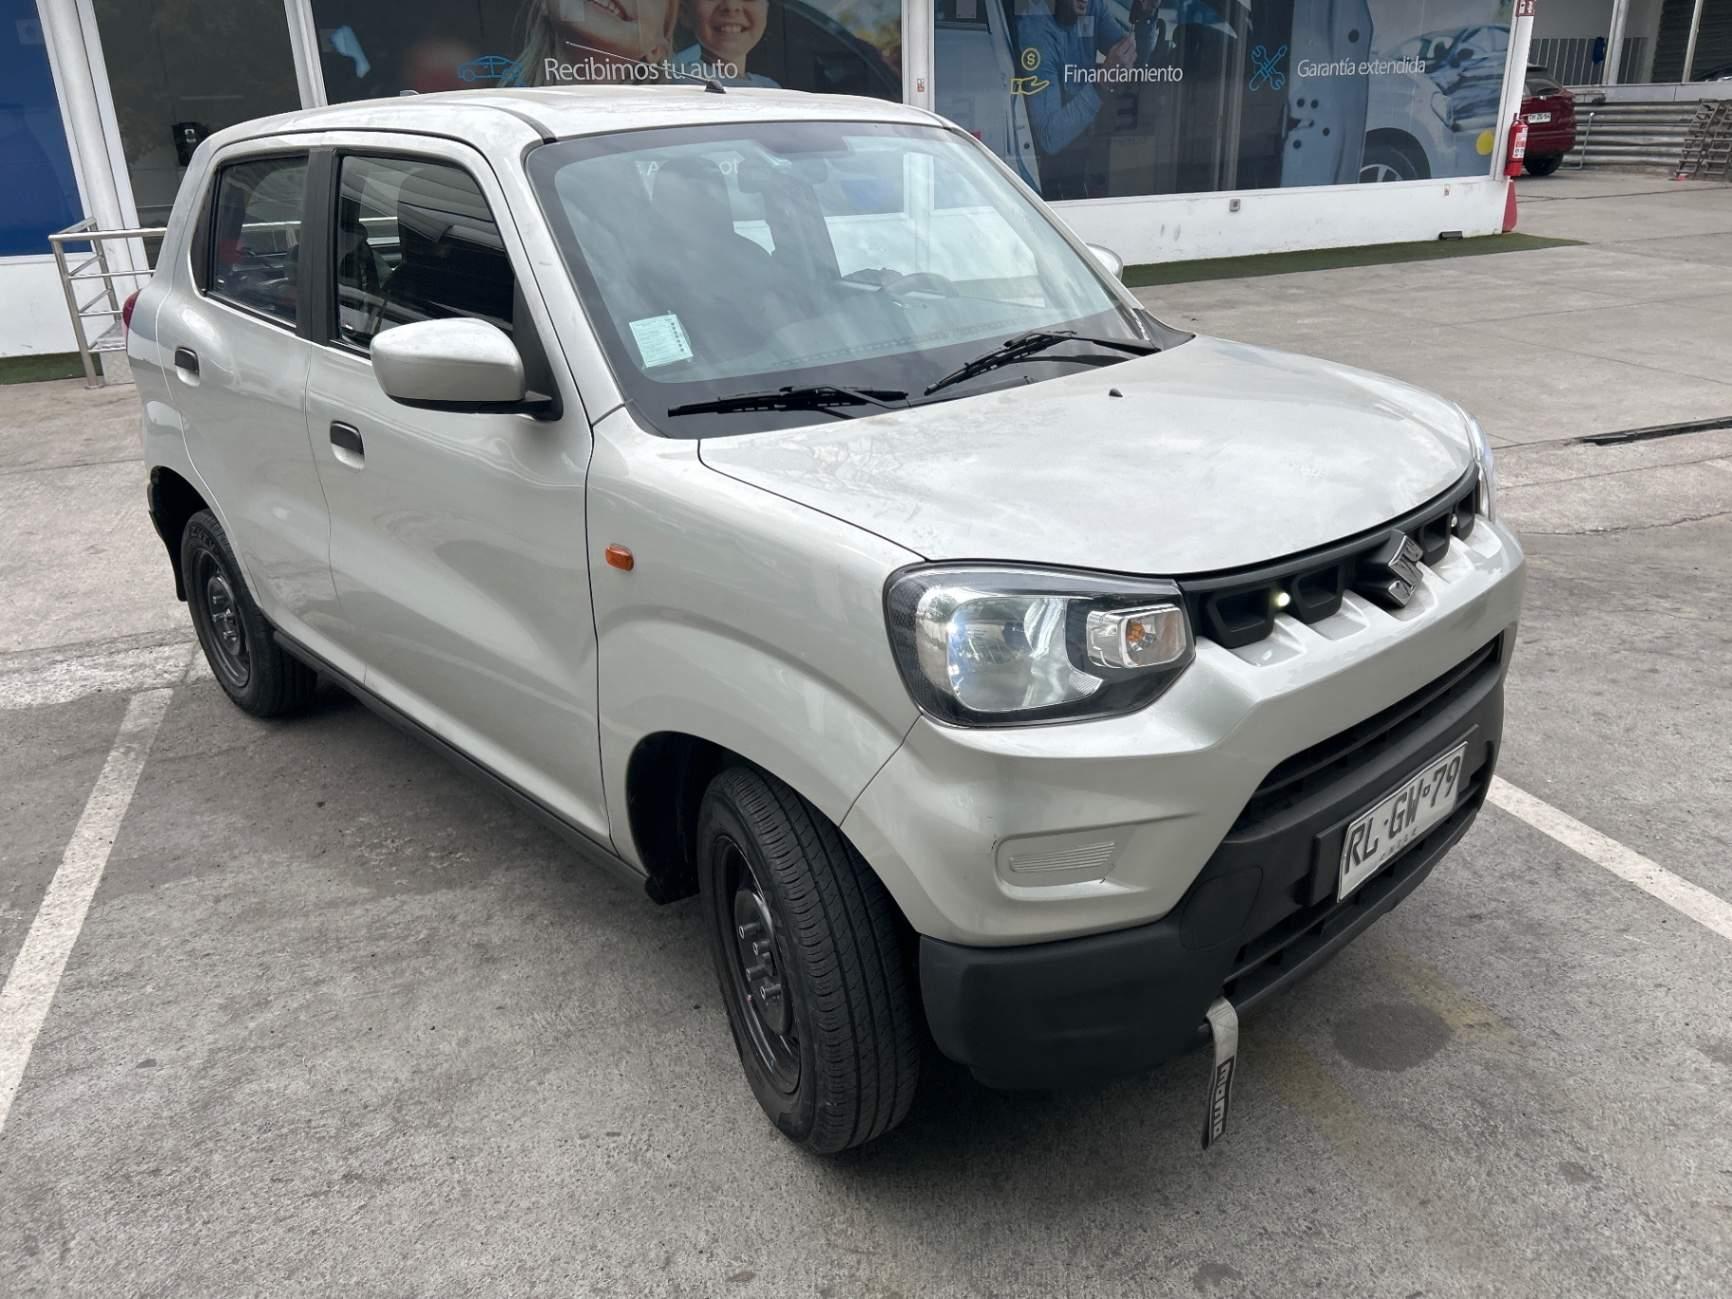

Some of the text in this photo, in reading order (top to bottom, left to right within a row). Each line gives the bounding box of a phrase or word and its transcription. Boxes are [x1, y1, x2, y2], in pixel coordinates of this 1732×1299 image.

[544, 57, 738, 81] Recibimos tu auto
[1064, 64, 1184, 83] Financiamiento
[1297, 56, 1426, 78] Garantía extendida
